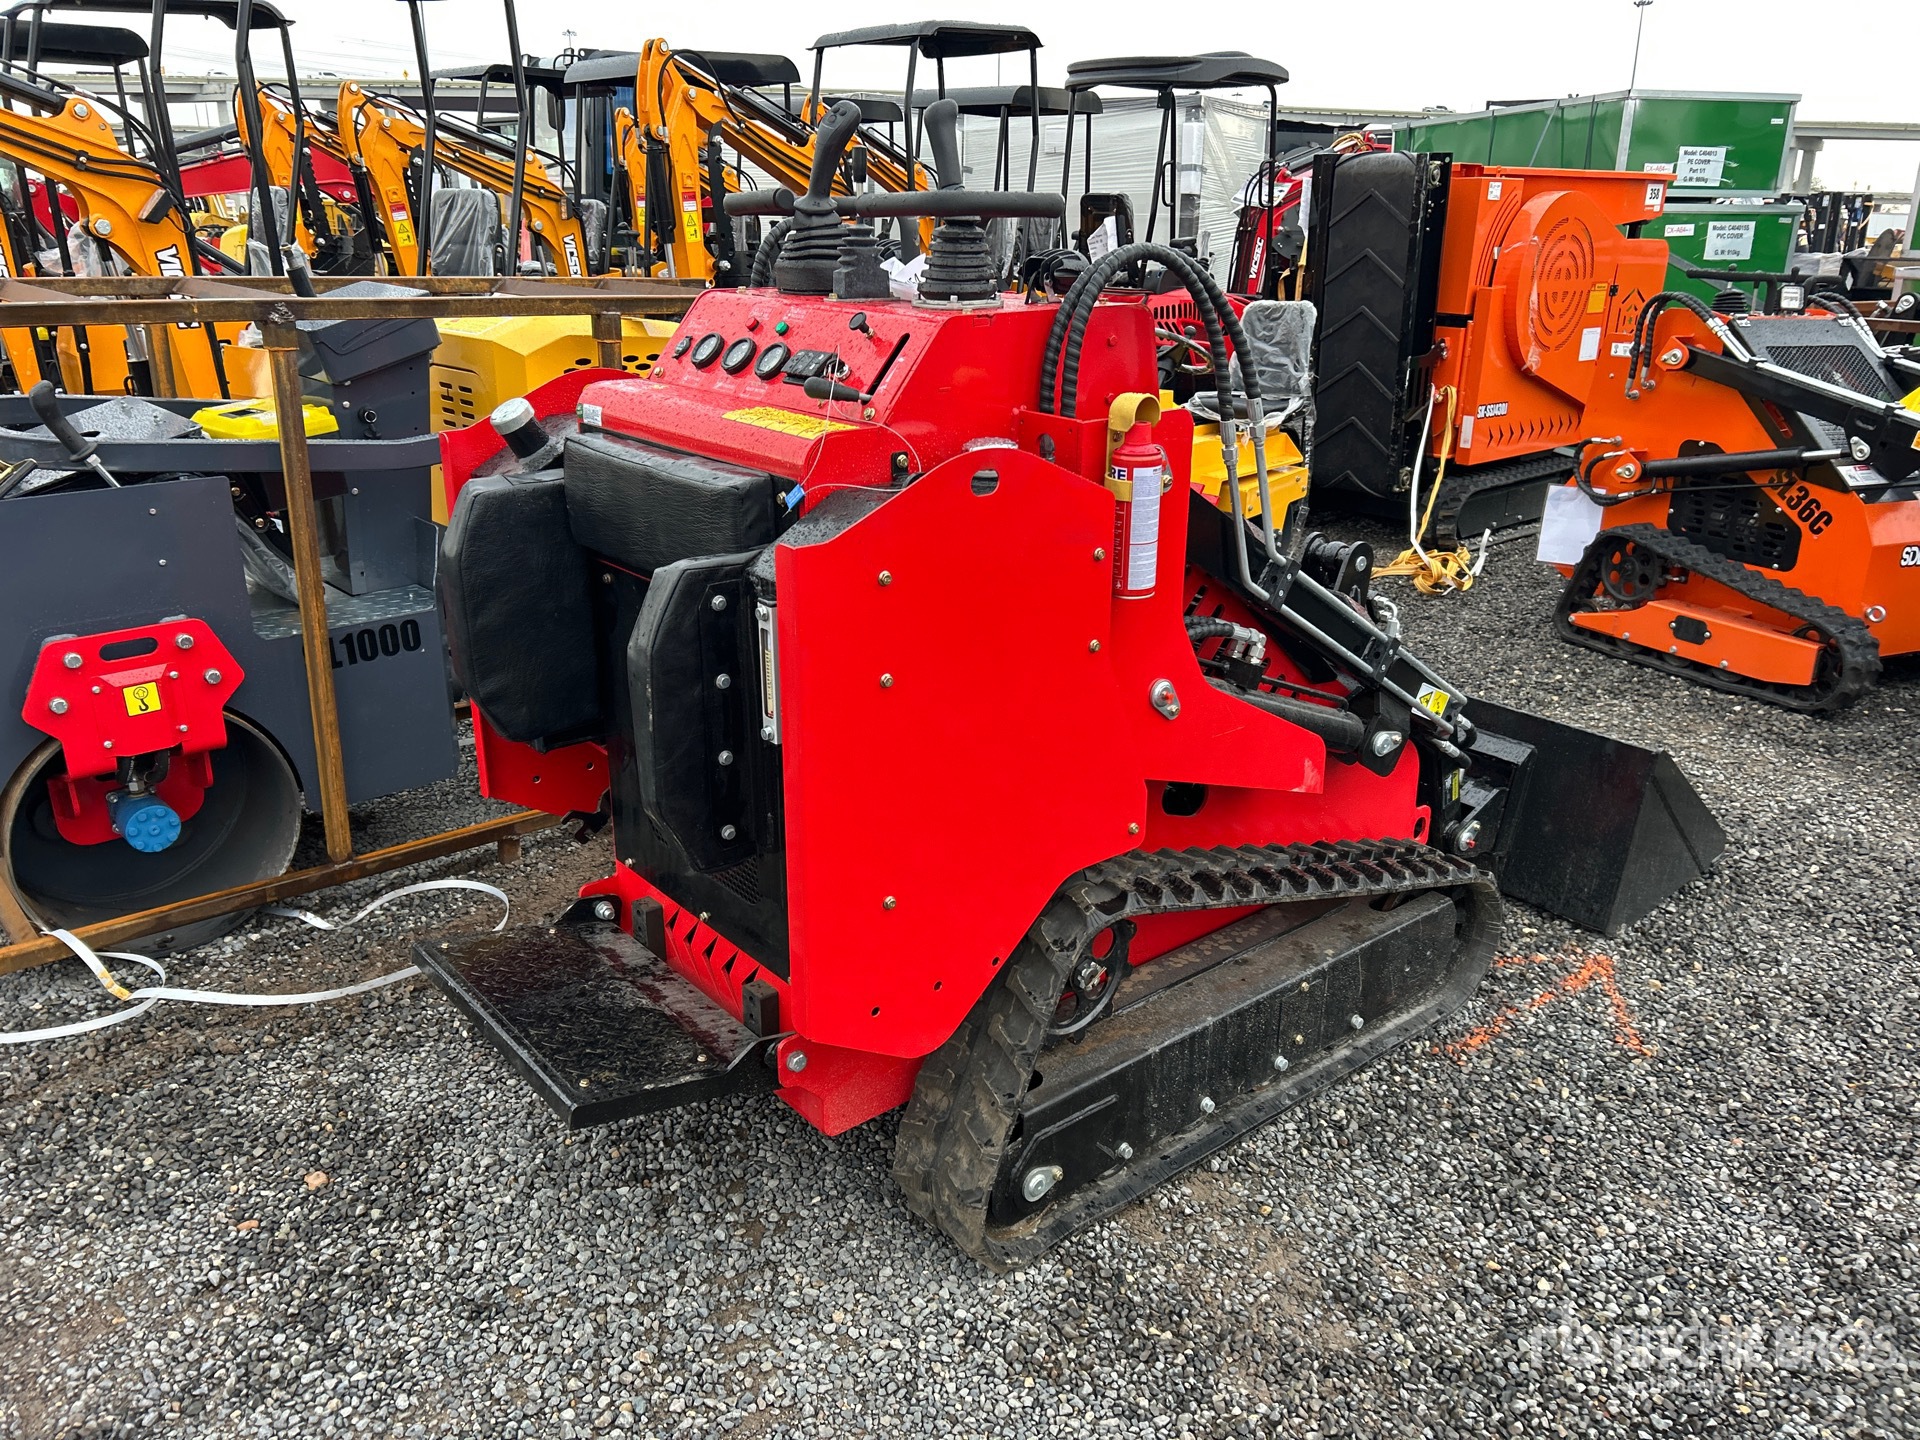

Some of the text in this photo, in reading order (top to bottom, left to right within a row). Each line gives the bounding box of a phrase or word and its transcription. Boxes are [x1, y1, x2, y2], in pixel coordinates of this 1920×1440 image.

[1649, 187, 1660, 200] 358
[562, 232, 582, 277] VICSE
[302, 619, 422, 670] L1000
